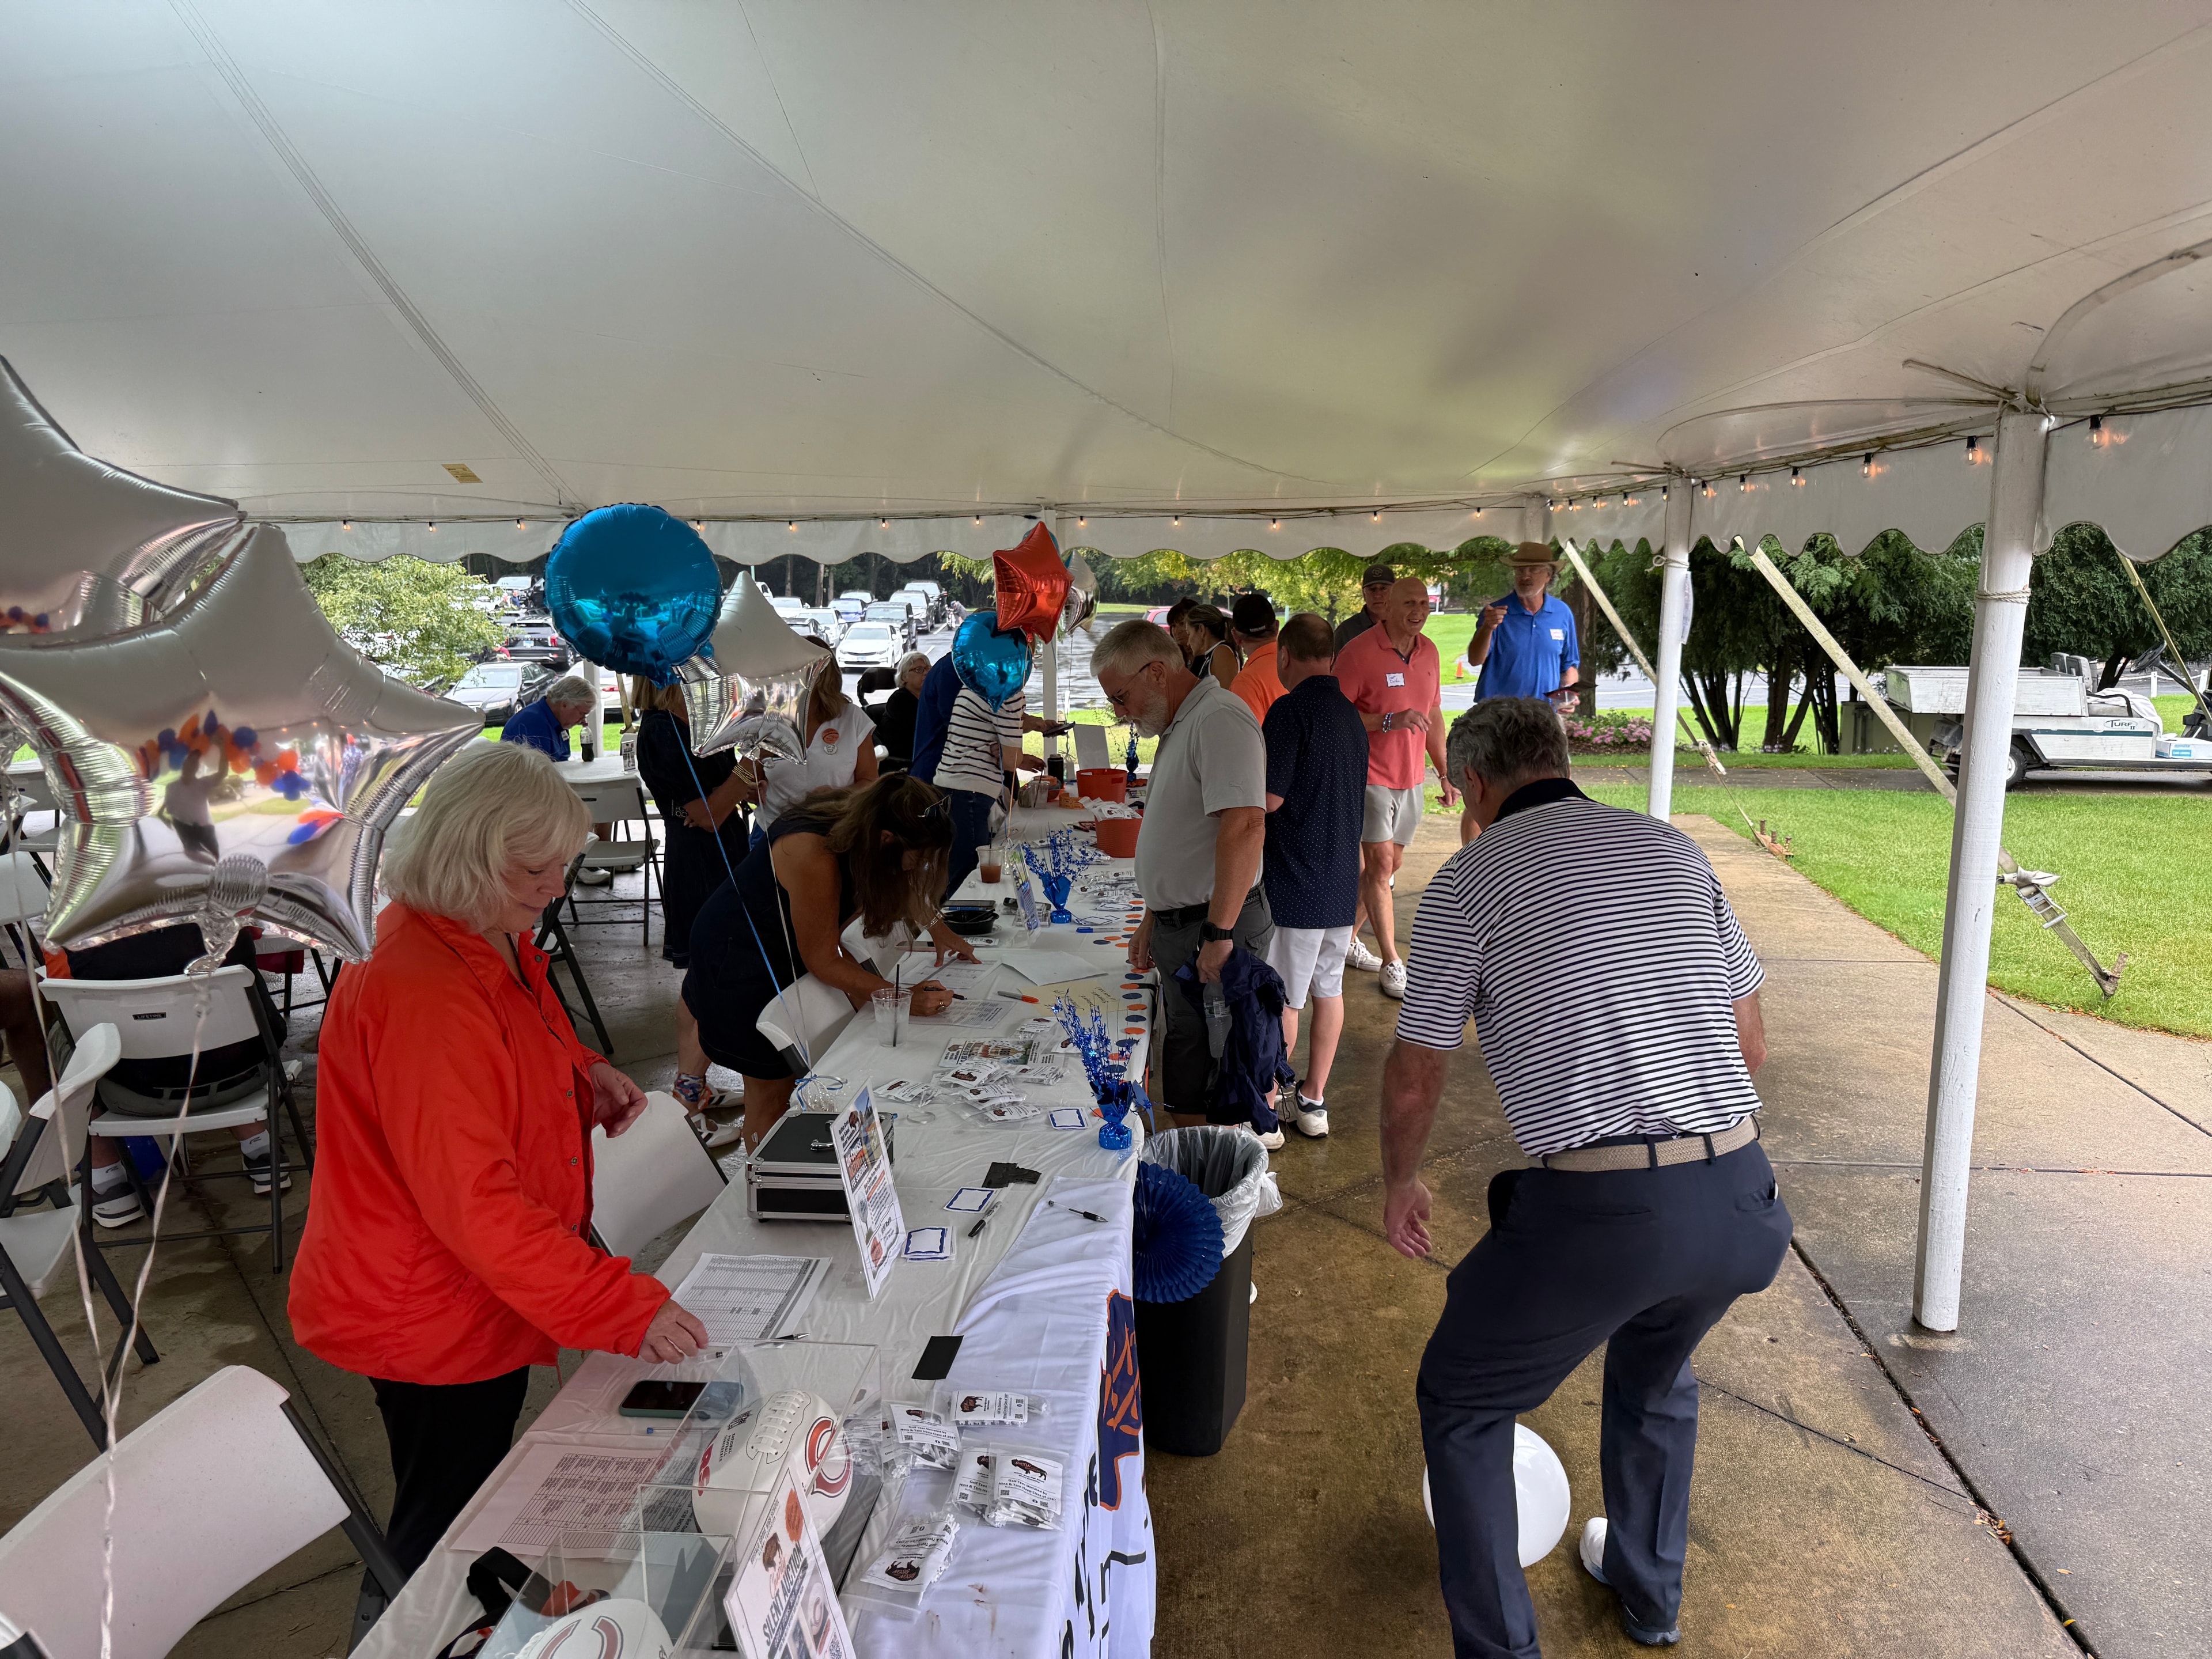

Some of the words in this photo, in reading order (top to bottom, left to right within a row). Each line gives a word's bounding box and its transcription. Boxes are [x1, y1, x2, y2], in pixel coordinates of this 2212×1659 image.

[846, 1139, 862, 1167] ON-COURSE
[848, 1149, 865, 1181] ACTIVITY
[855, 1161, 868, 1182] SCHEDULE
[719, 1434, 728, 1462] CONFERENCE
[751, 1543, 760, 1565] BUFFALO
[759, 1528, 767, 1544] GROVE
[771, 1499, 779, 1518] SCHOOL
[770, 1555, 785, 1599] Charity
[763, 1589, 783, 1647] SILENT
[781, 1540, 804, 1602] AUCTION
[774, 1625, 783, 1648] GREAT
